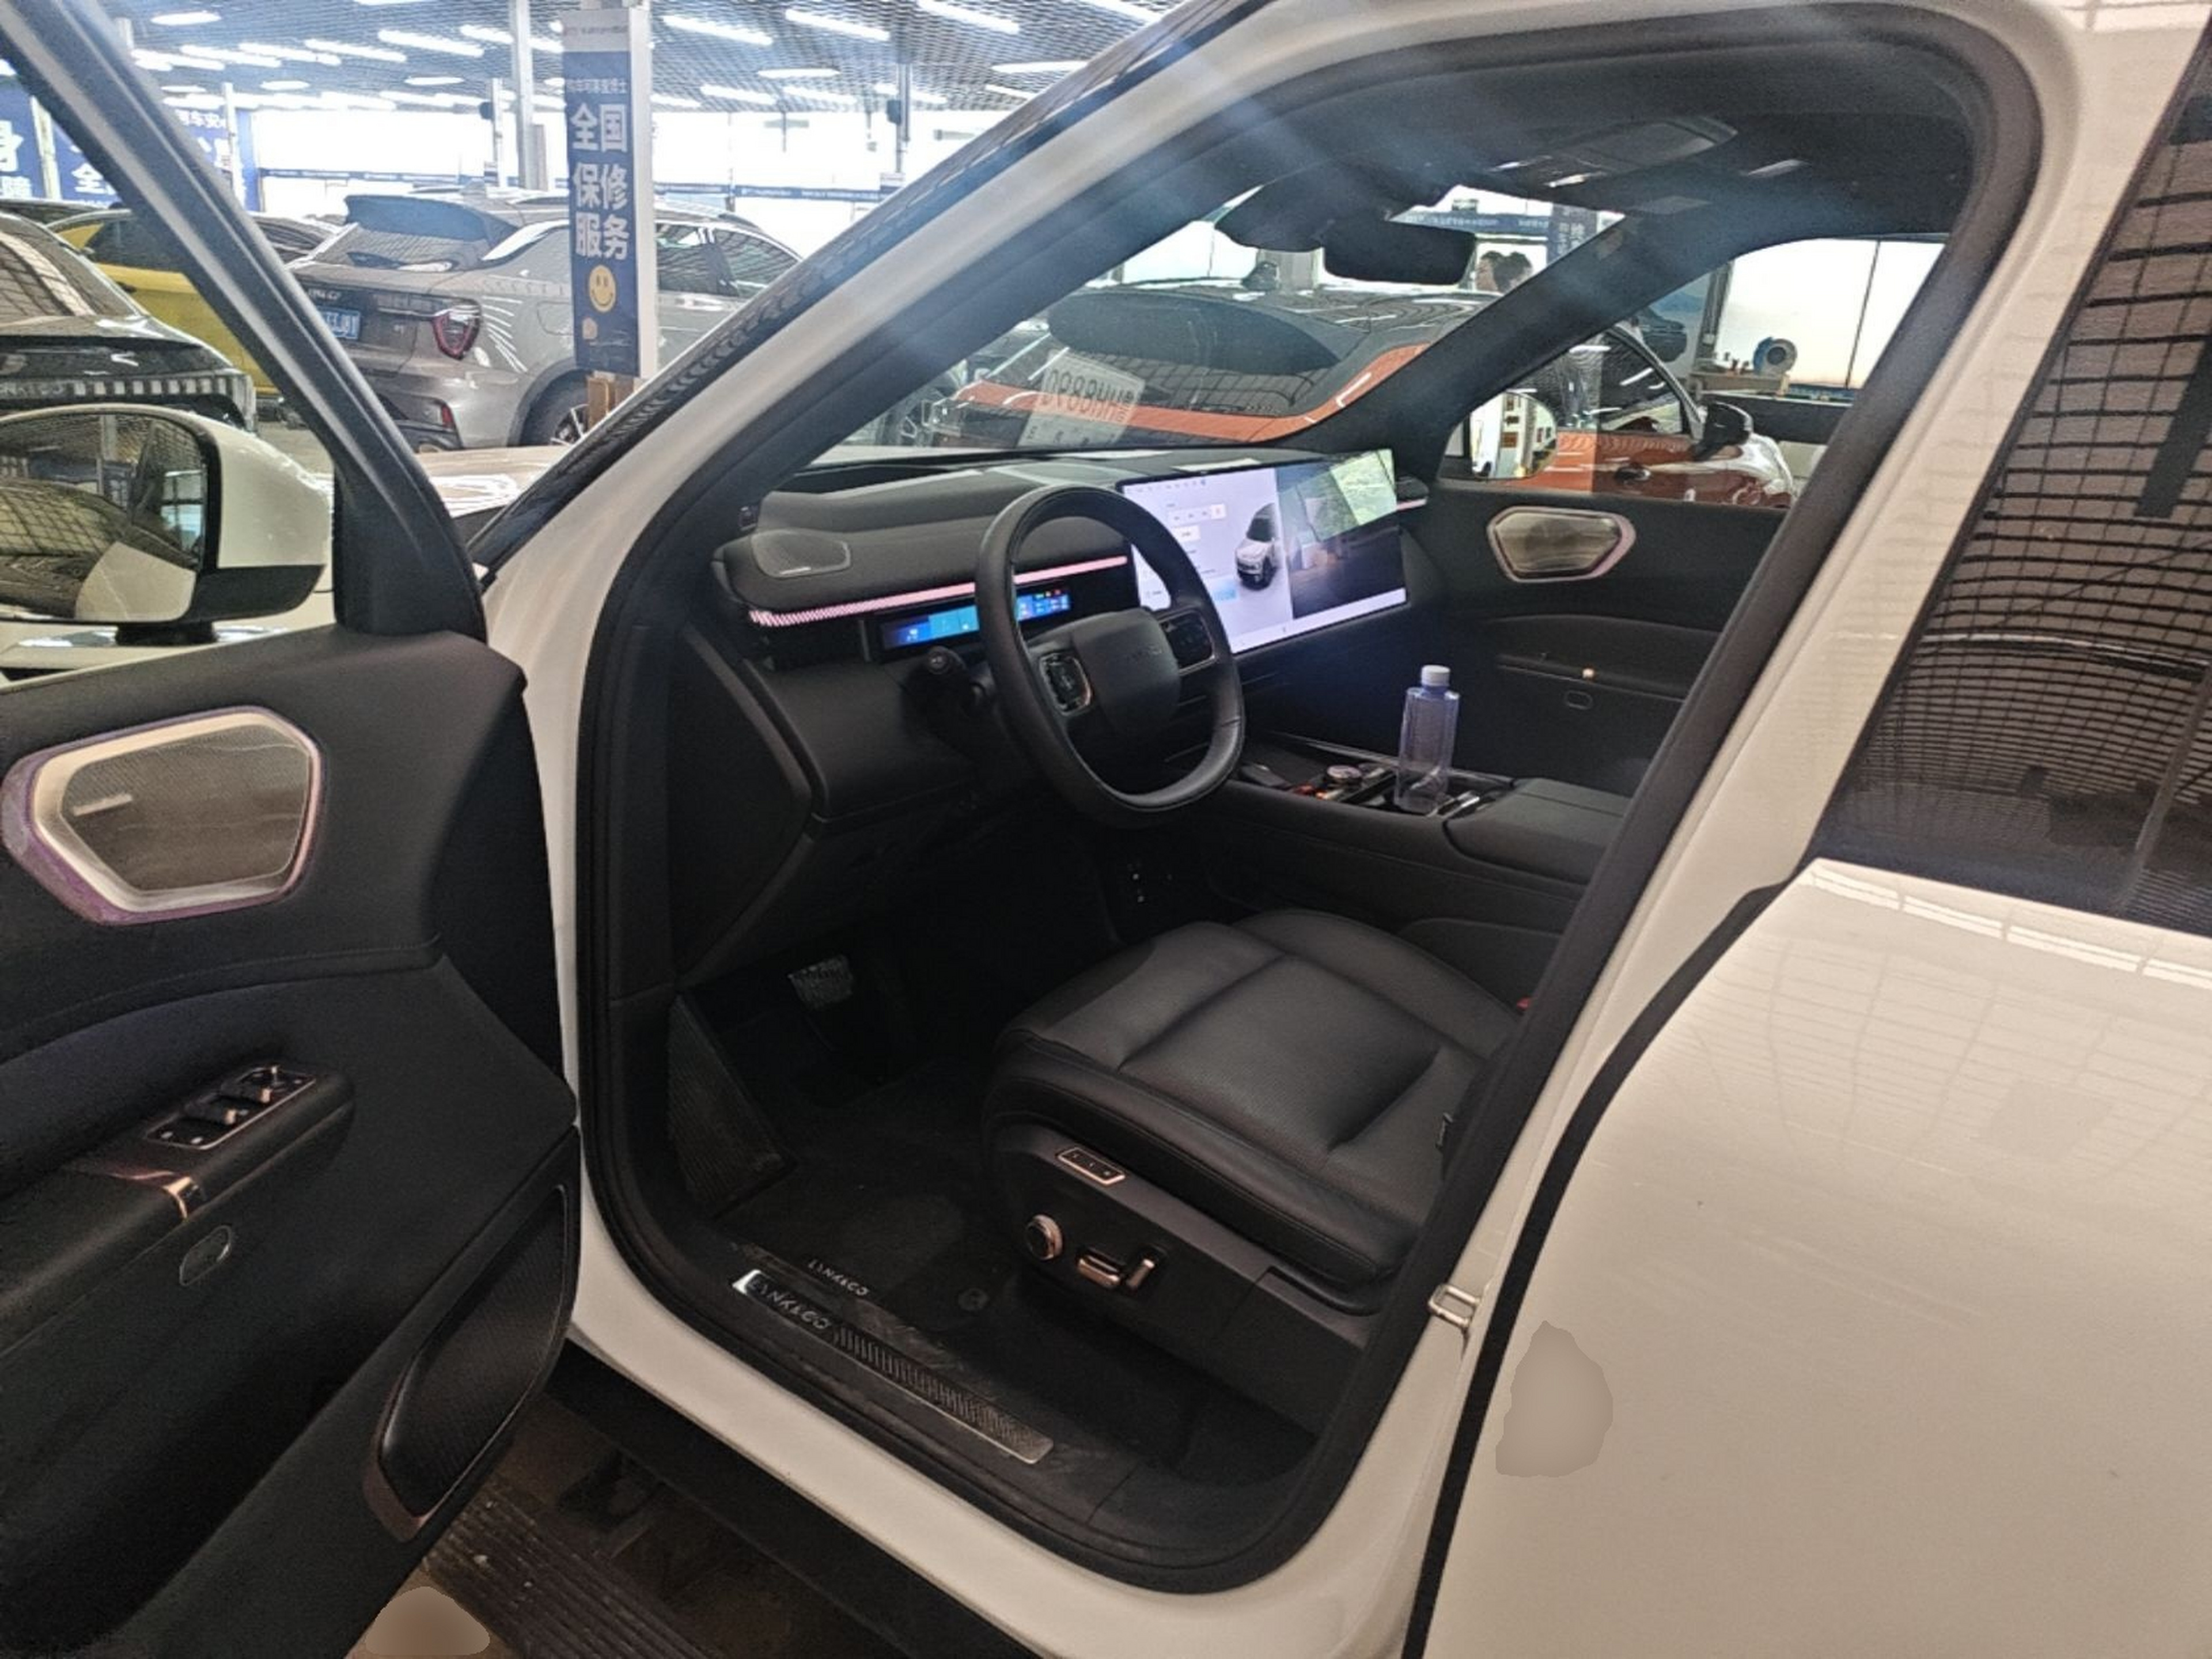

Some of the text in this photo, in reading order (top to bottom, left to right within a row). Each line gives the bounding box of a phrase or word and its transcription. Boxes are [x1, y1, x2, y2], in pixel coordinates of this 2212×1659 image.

[570, 103, 627, 152] 全国
[573, 162, 627, 210] 保修
[575, 211, 630, 261] 服务
